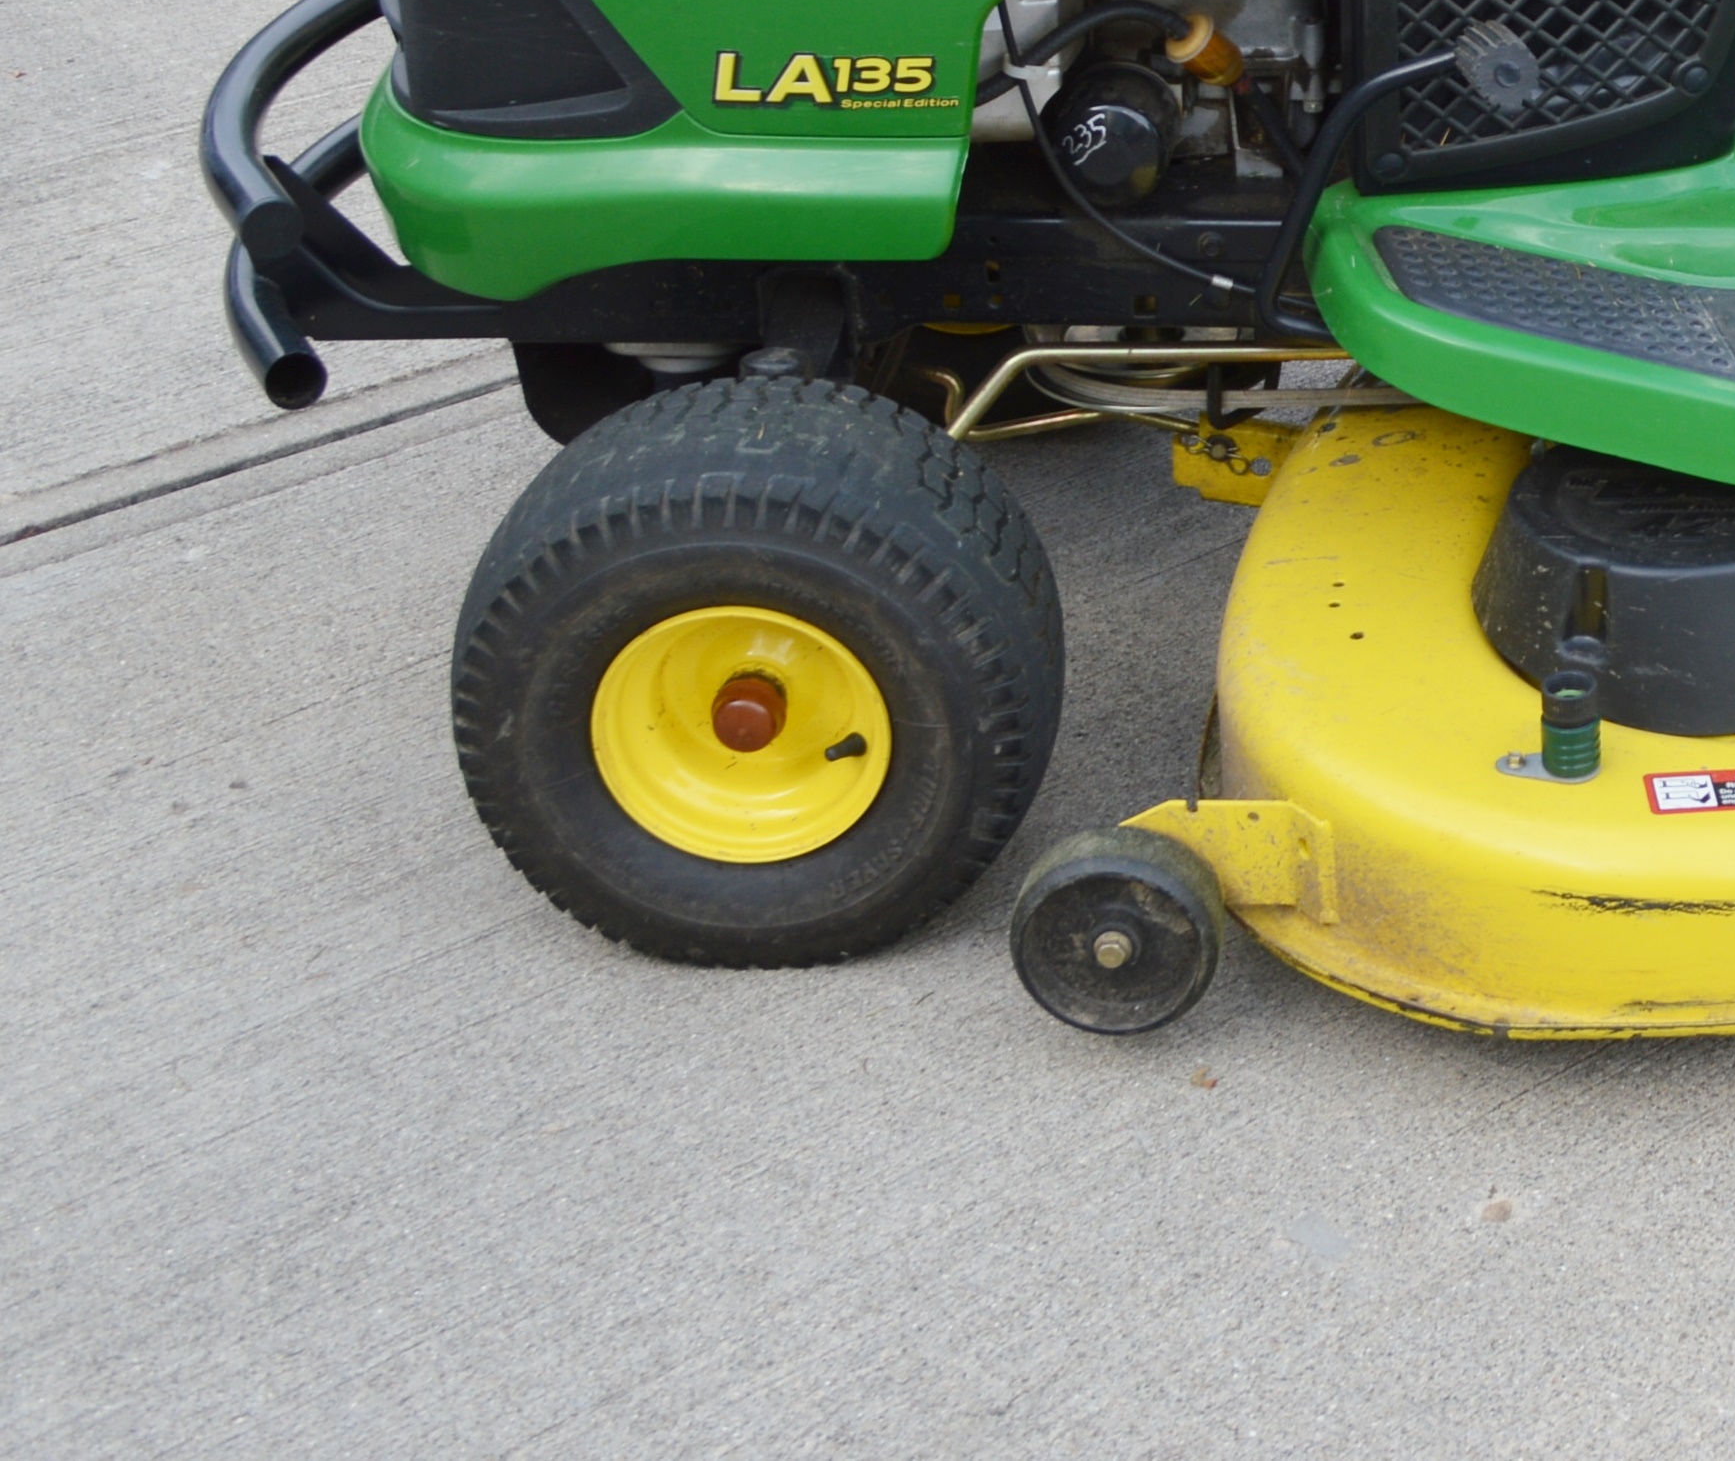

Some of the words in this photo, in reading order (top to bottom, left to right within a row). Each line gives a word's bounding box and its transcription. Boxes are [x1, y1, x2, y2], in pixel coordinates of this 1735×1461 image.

[840, 98, 900, 110] Special
[902, 97, 960, 108] Edition
[1061, 112, 1107, 156] 235
